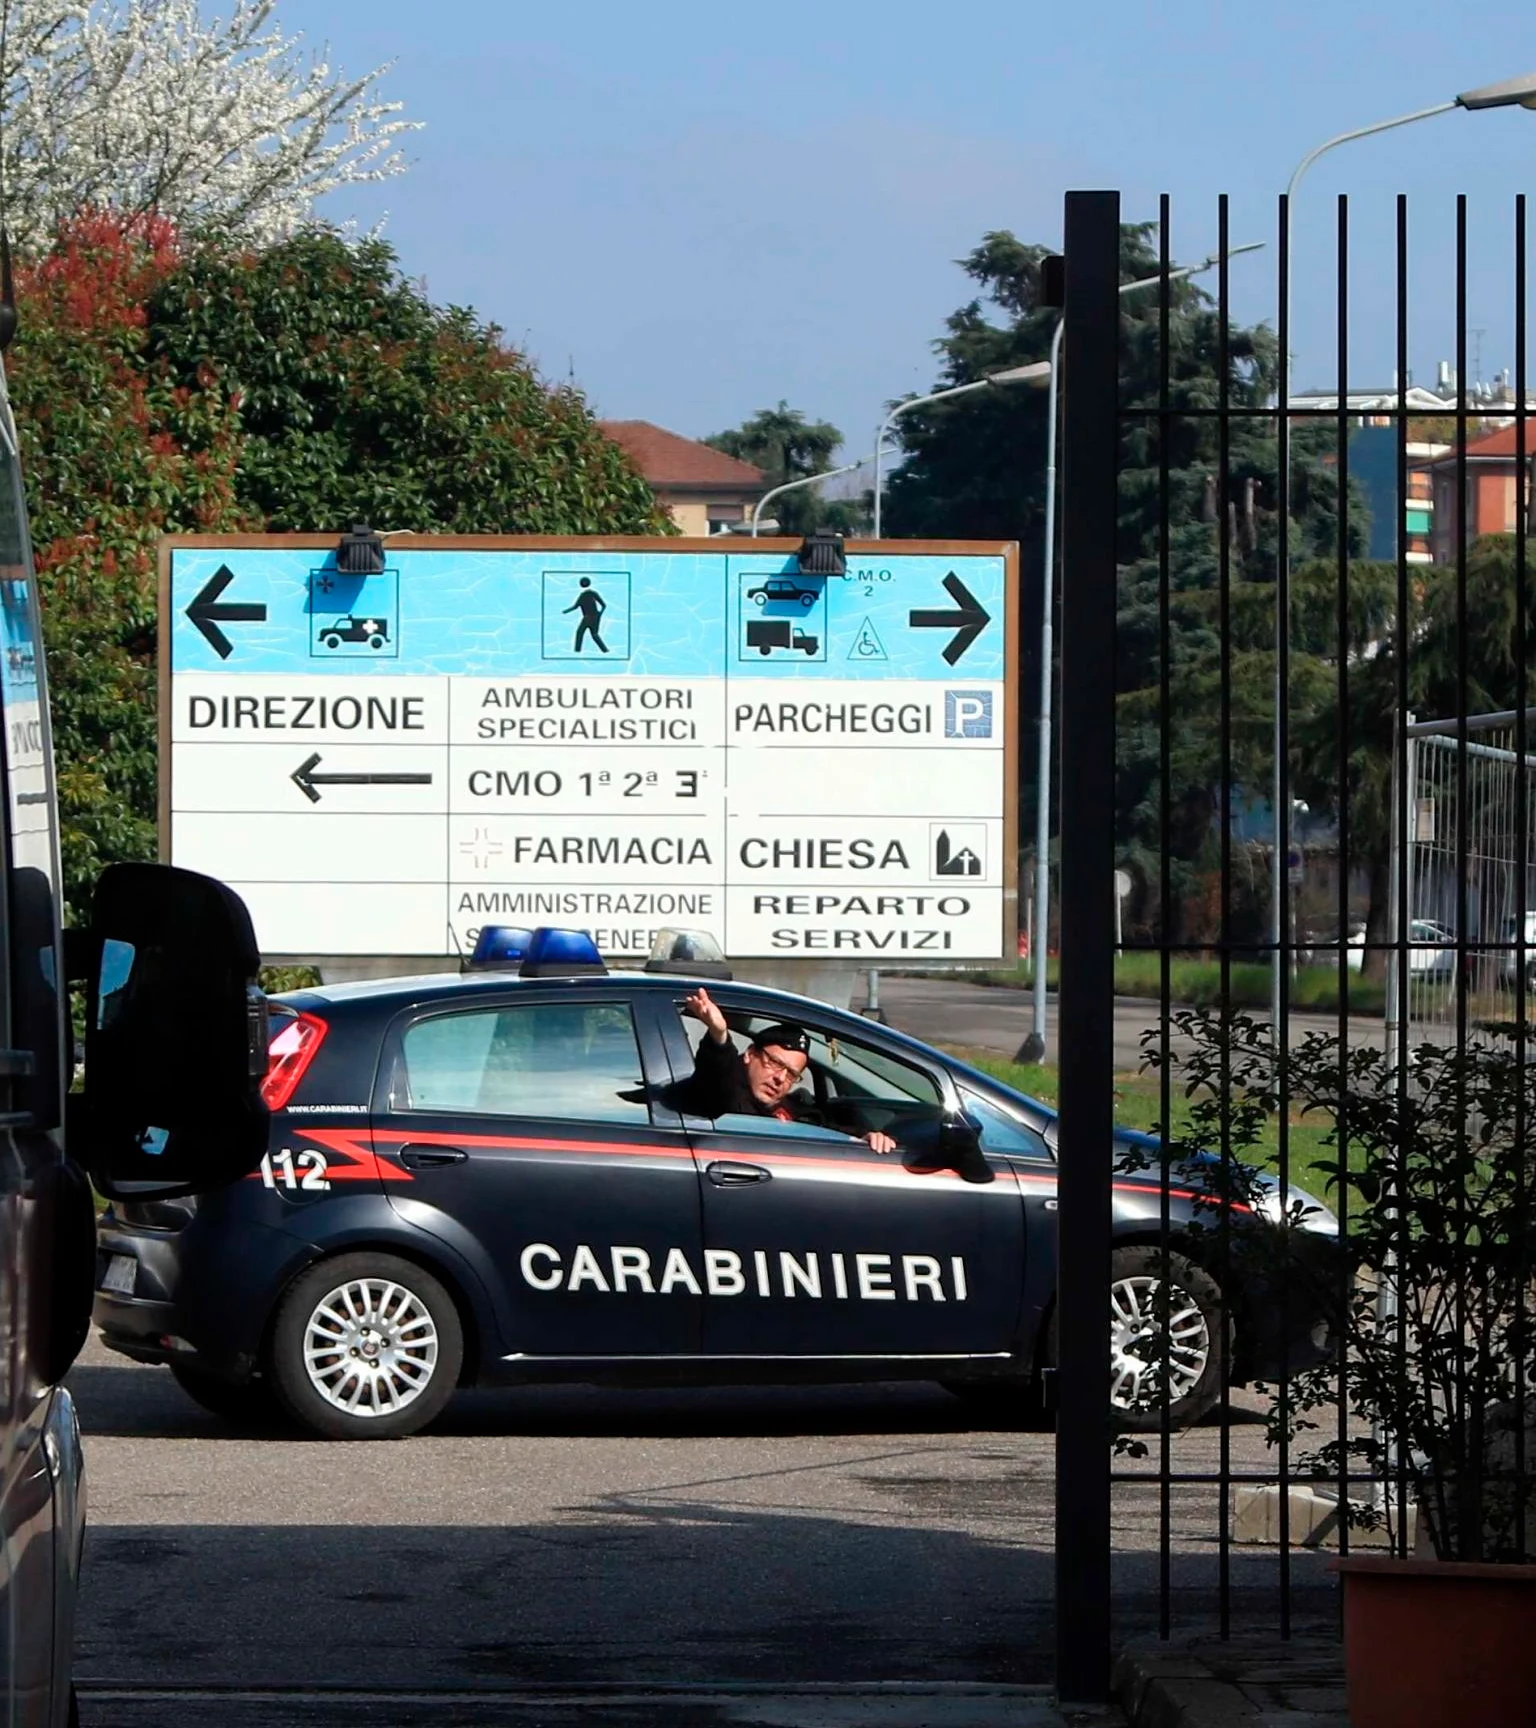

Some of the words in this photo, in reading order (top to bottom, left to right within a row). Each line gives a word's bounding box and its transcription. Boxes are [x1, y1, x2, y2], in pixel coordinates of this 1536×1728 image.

[864, 585, 874, 597] 2
[481, 687, 692, 709] AMBULATORI
[189, 696, 424, 730] DIREZIONE
[735, 703, 931, 734] PARCHEGGI
[955, 697, 984, 734] P
[478, 717, 696, 740] SPECIALISTICI
[468, 770, 562, 797] CMO
[514, 836, 712, 866] FARMACIA
[739, 838, 910, 870] CHIESA
[458, 892, 713, 915] AMMINISTRAZIONE
[753, 895, 971, 916] REPARTO
[771, 929, 952, 950] SERVIZI
[260, 1148, 332, 1191] 112
[519, 1242, 968, 1302] CARABINIERI
